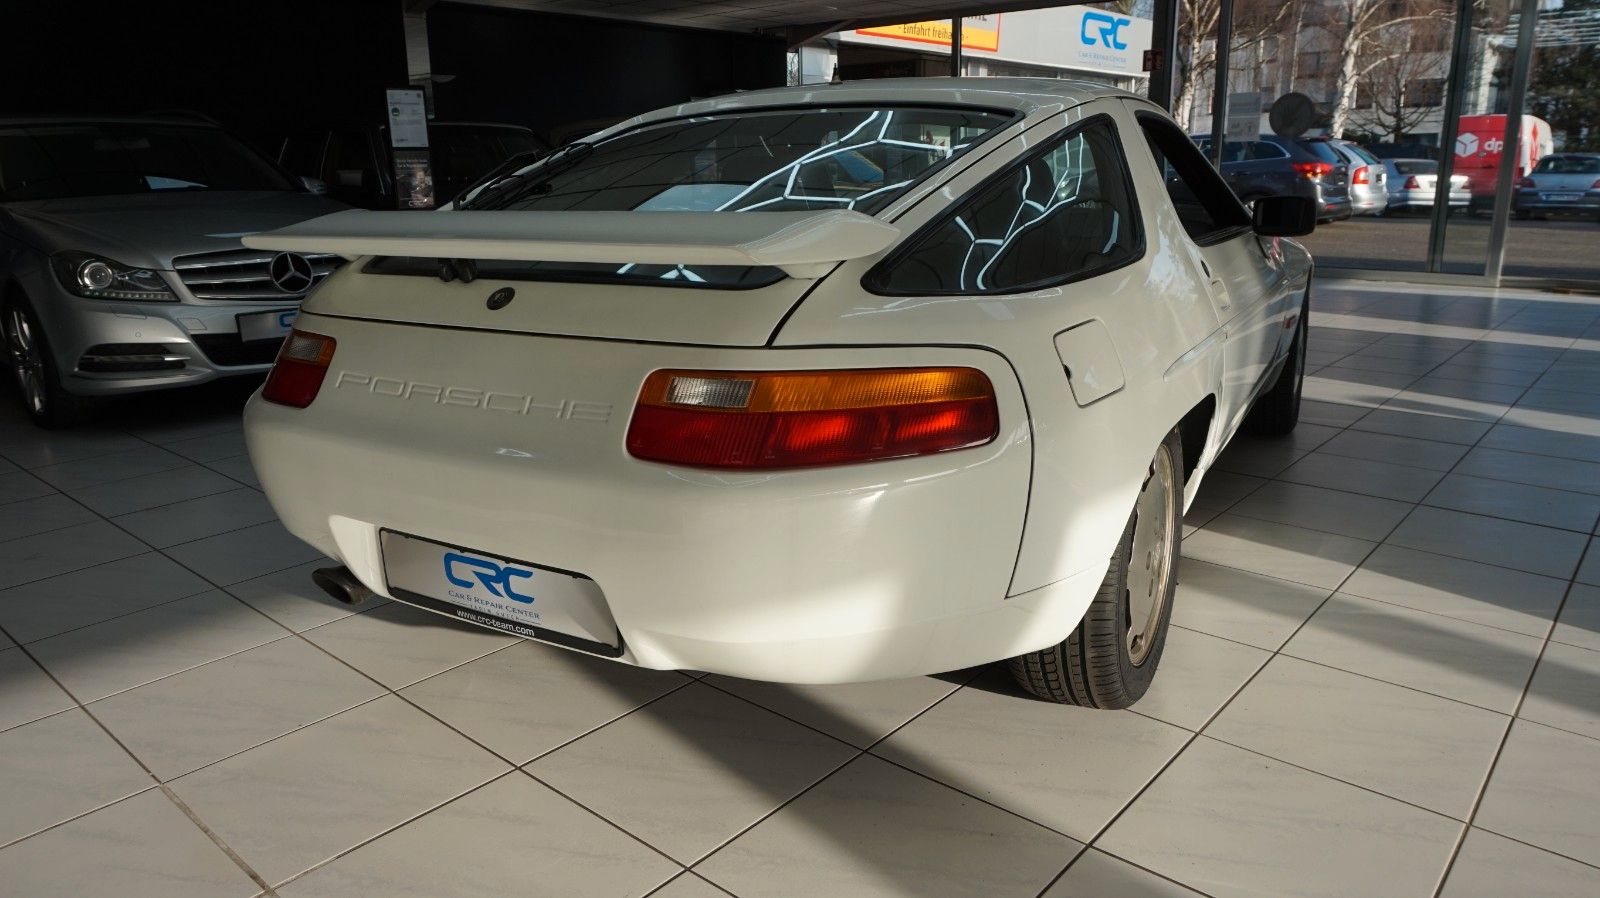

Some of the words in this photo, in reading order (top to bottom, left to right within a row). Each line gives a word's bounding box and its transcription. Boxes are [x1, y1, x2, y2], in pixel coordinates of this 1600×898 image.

[903, 24, 931, 37] Einfahrt
[1081, 12, 1130, 50] CRC
[1484, 137, 1504, 154] dp
[335, 370, 613, 424] PORSCHE
[443, 552, 535, 605] CRC
[456, 609, 535, 637] www.crc-team.com
